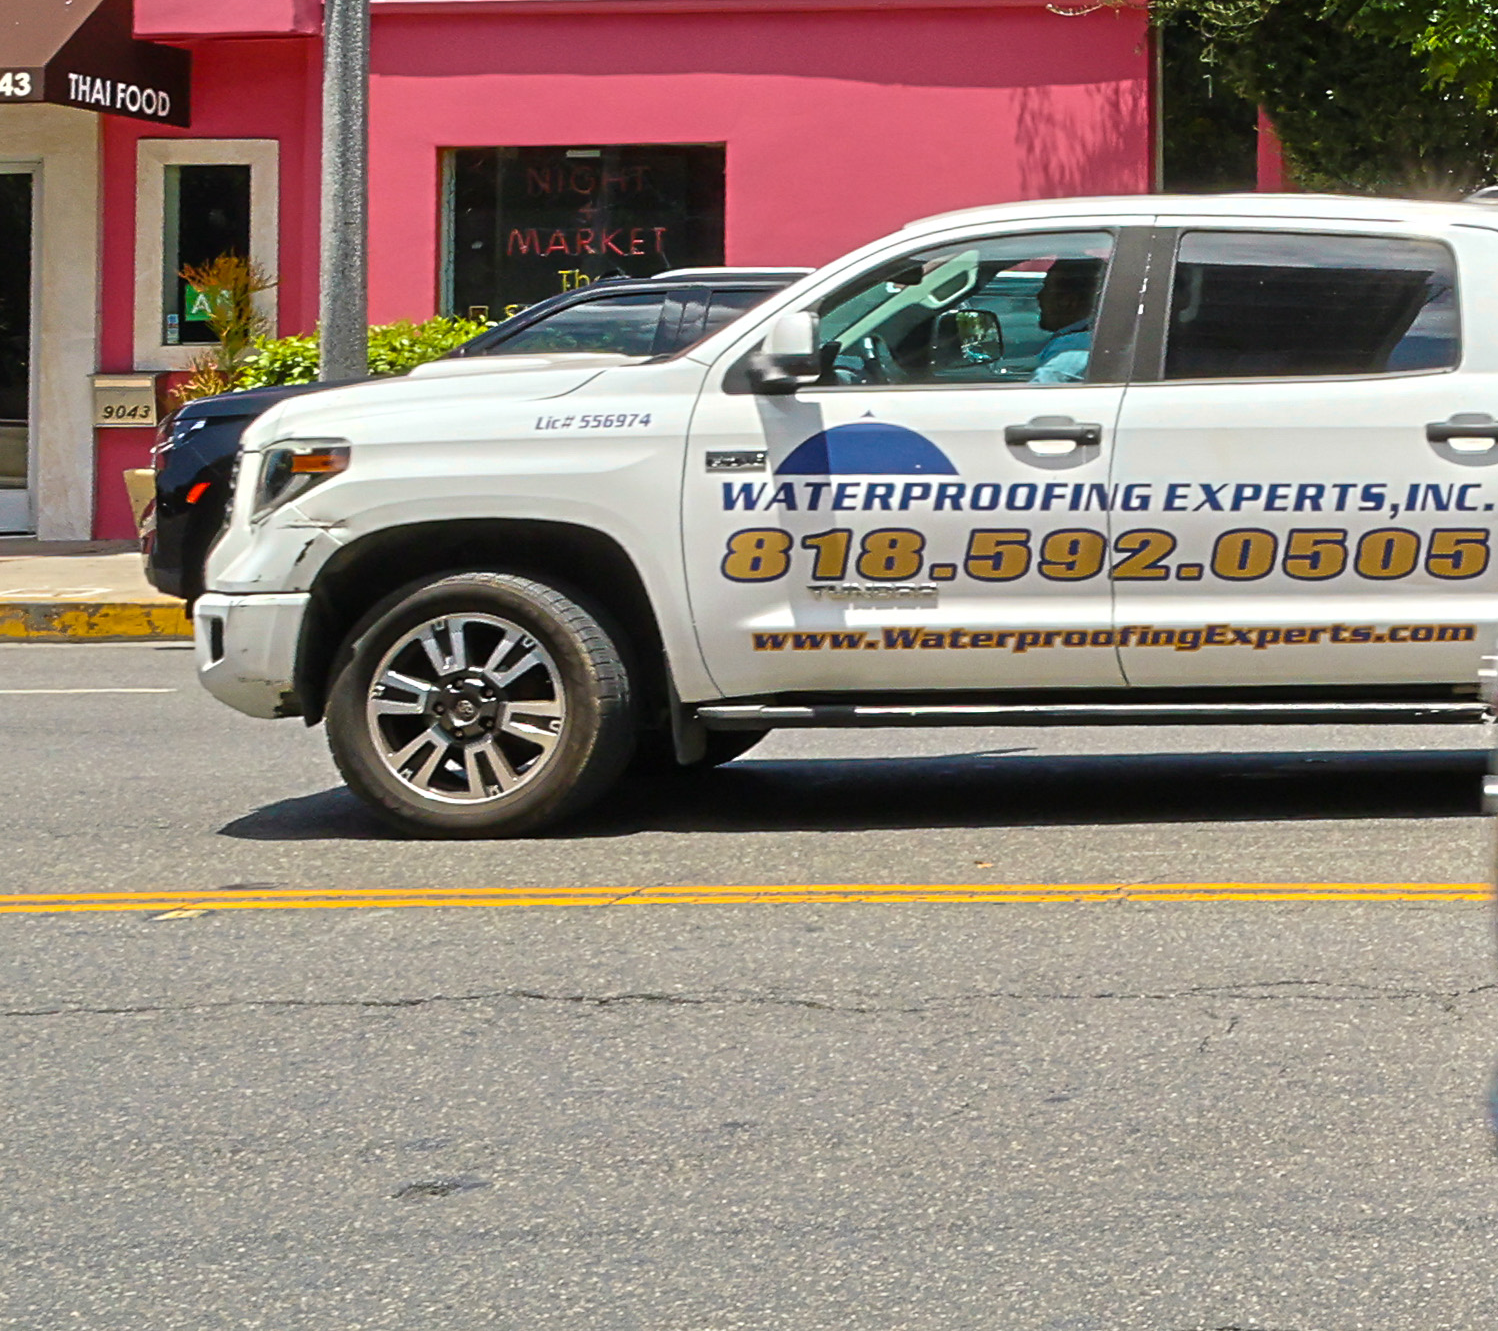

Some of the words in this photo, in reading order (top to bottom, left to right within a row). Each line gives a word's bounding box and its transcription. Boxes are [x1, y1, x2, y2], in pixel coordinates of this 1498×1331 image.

[68, 72, 111, 107] THAI
[116, 82, 171, 117] FOOD
[527, 165, 650, 195] NIGHT
[507, 227, 668, 256] MARKET
[102, 405, 150, 419] 9043
[535, 414, 576, 430] Lic#
[578, 413, 652, 429] 556974
[721, 482, 1153, 512] WATERPROOFING
[720, 527, 1492, 583] 818.592.0505
[752, 624, 1477, 654] www.WaterproofingExperts.com
